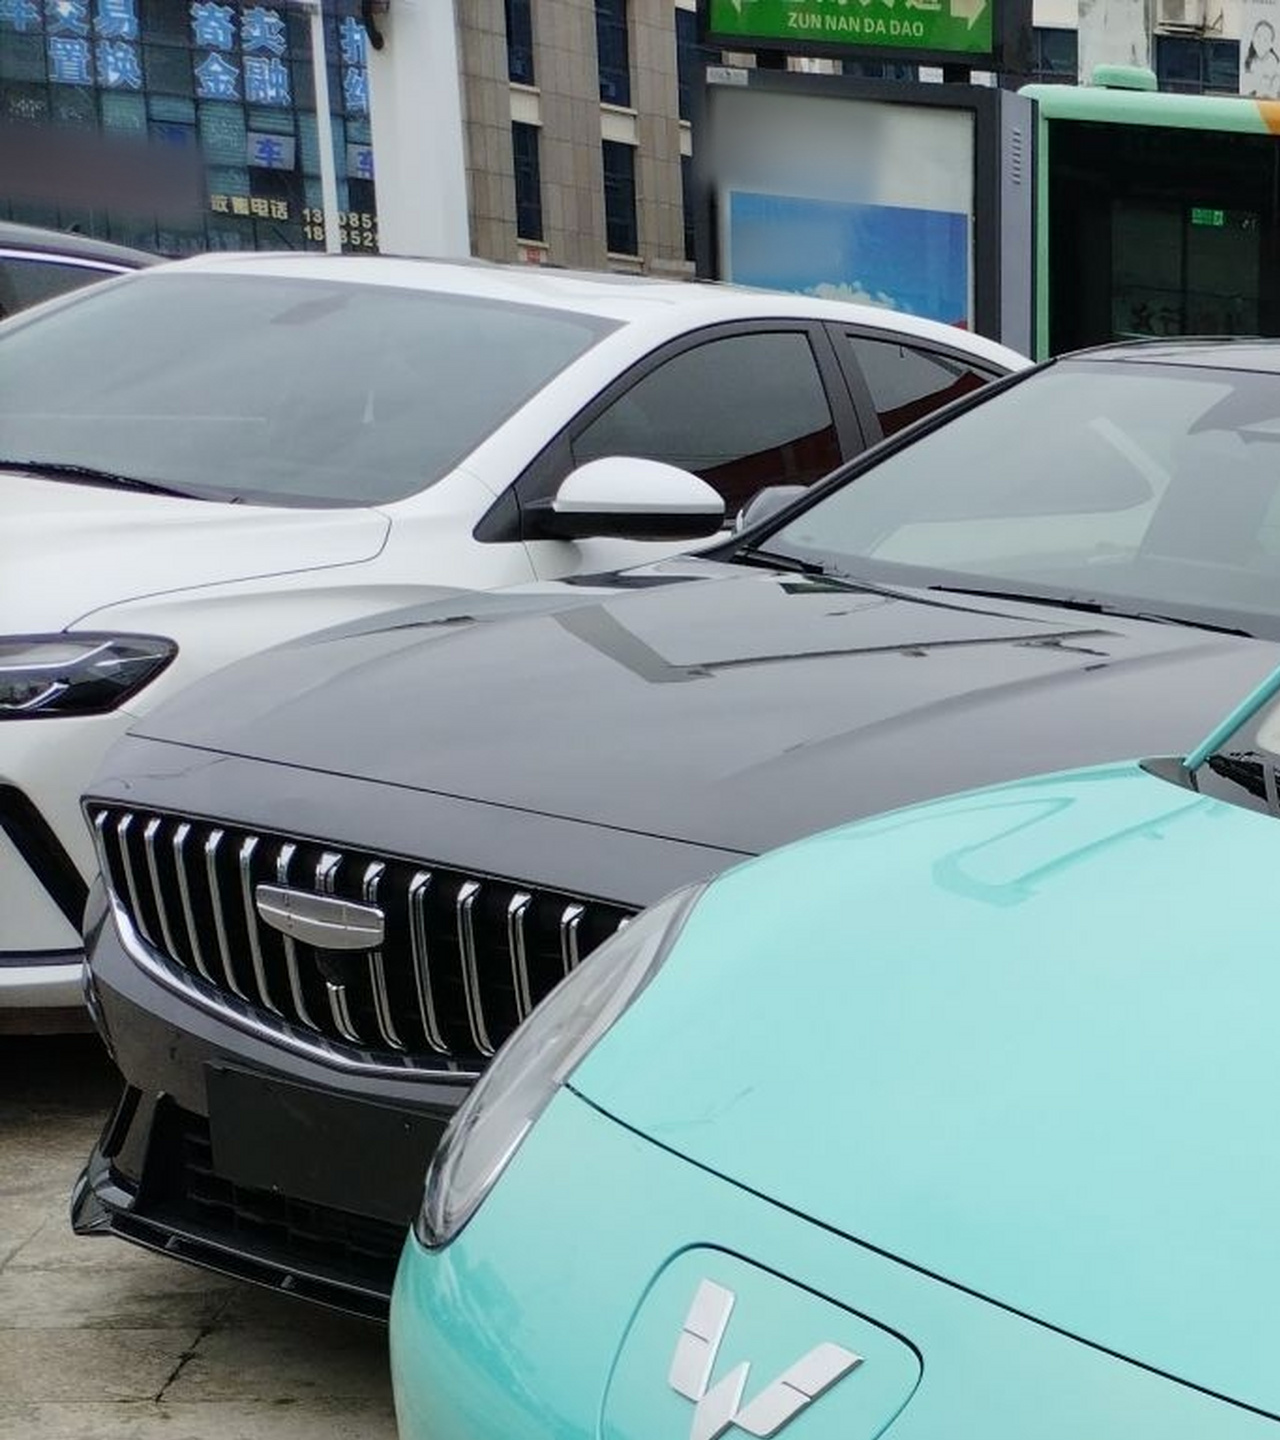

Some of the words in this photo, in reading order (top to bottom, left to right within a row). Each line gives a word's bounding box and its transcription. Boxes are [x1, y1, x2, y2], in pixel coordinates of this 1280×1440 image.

[787, 12, 822, 29] ZUN
[825, 17, 860, 33] NAN
[863, 19, 887, 34] DA
[890, 20, 924, 37] DAO
[49, 37, 142, 89] 置换
[194, 52, 291, 106] 金融
